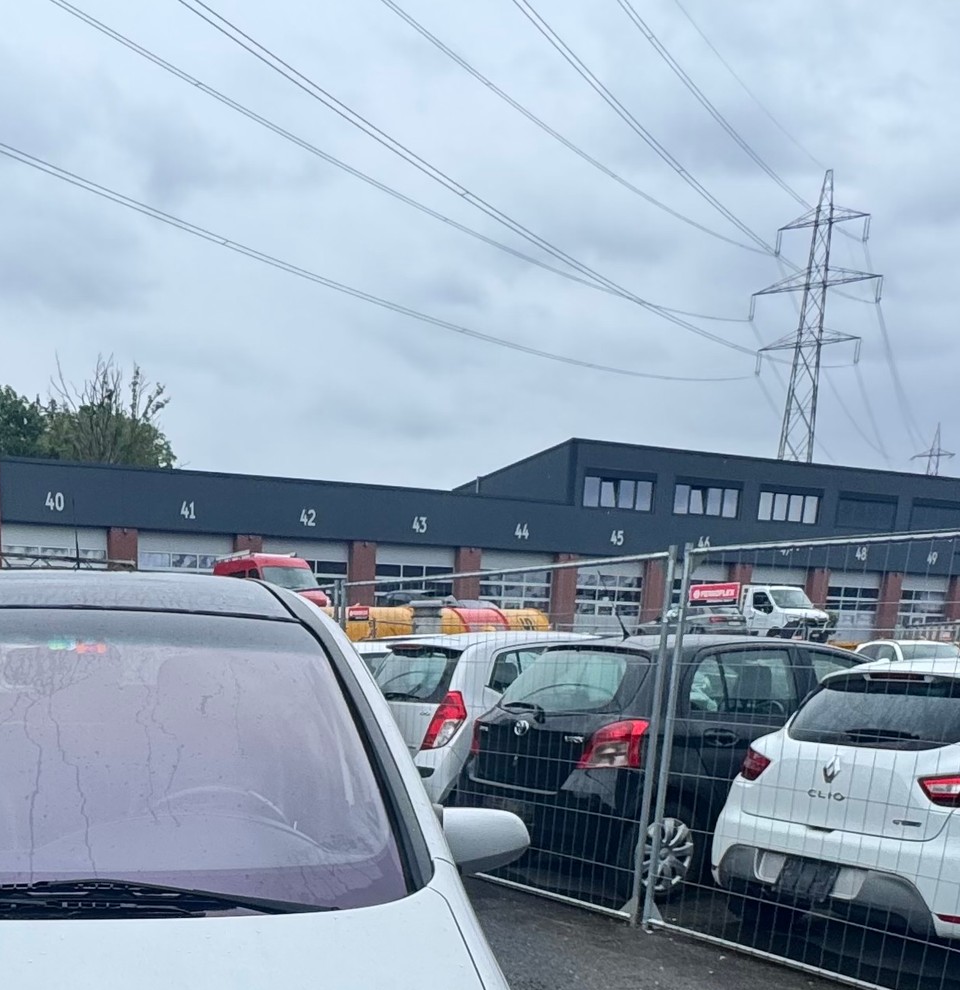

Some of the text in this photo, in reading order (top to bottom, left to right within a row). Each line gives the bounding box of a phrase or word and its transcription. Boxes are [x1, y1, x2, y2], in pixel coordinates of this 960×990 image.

[45, 491, 65, 512] 40
[180, 500, 196, 520] 41
[299, 508, 316, 527] 42
[412, 516, 427, 533] 43
[514, 523, 530, 540] 44
[610, 530, 624, 546] 45
[855, 546, 868, 561] 48
[926, 551, 938, 565] 49
[807, 789, 845, 802] CLIO
